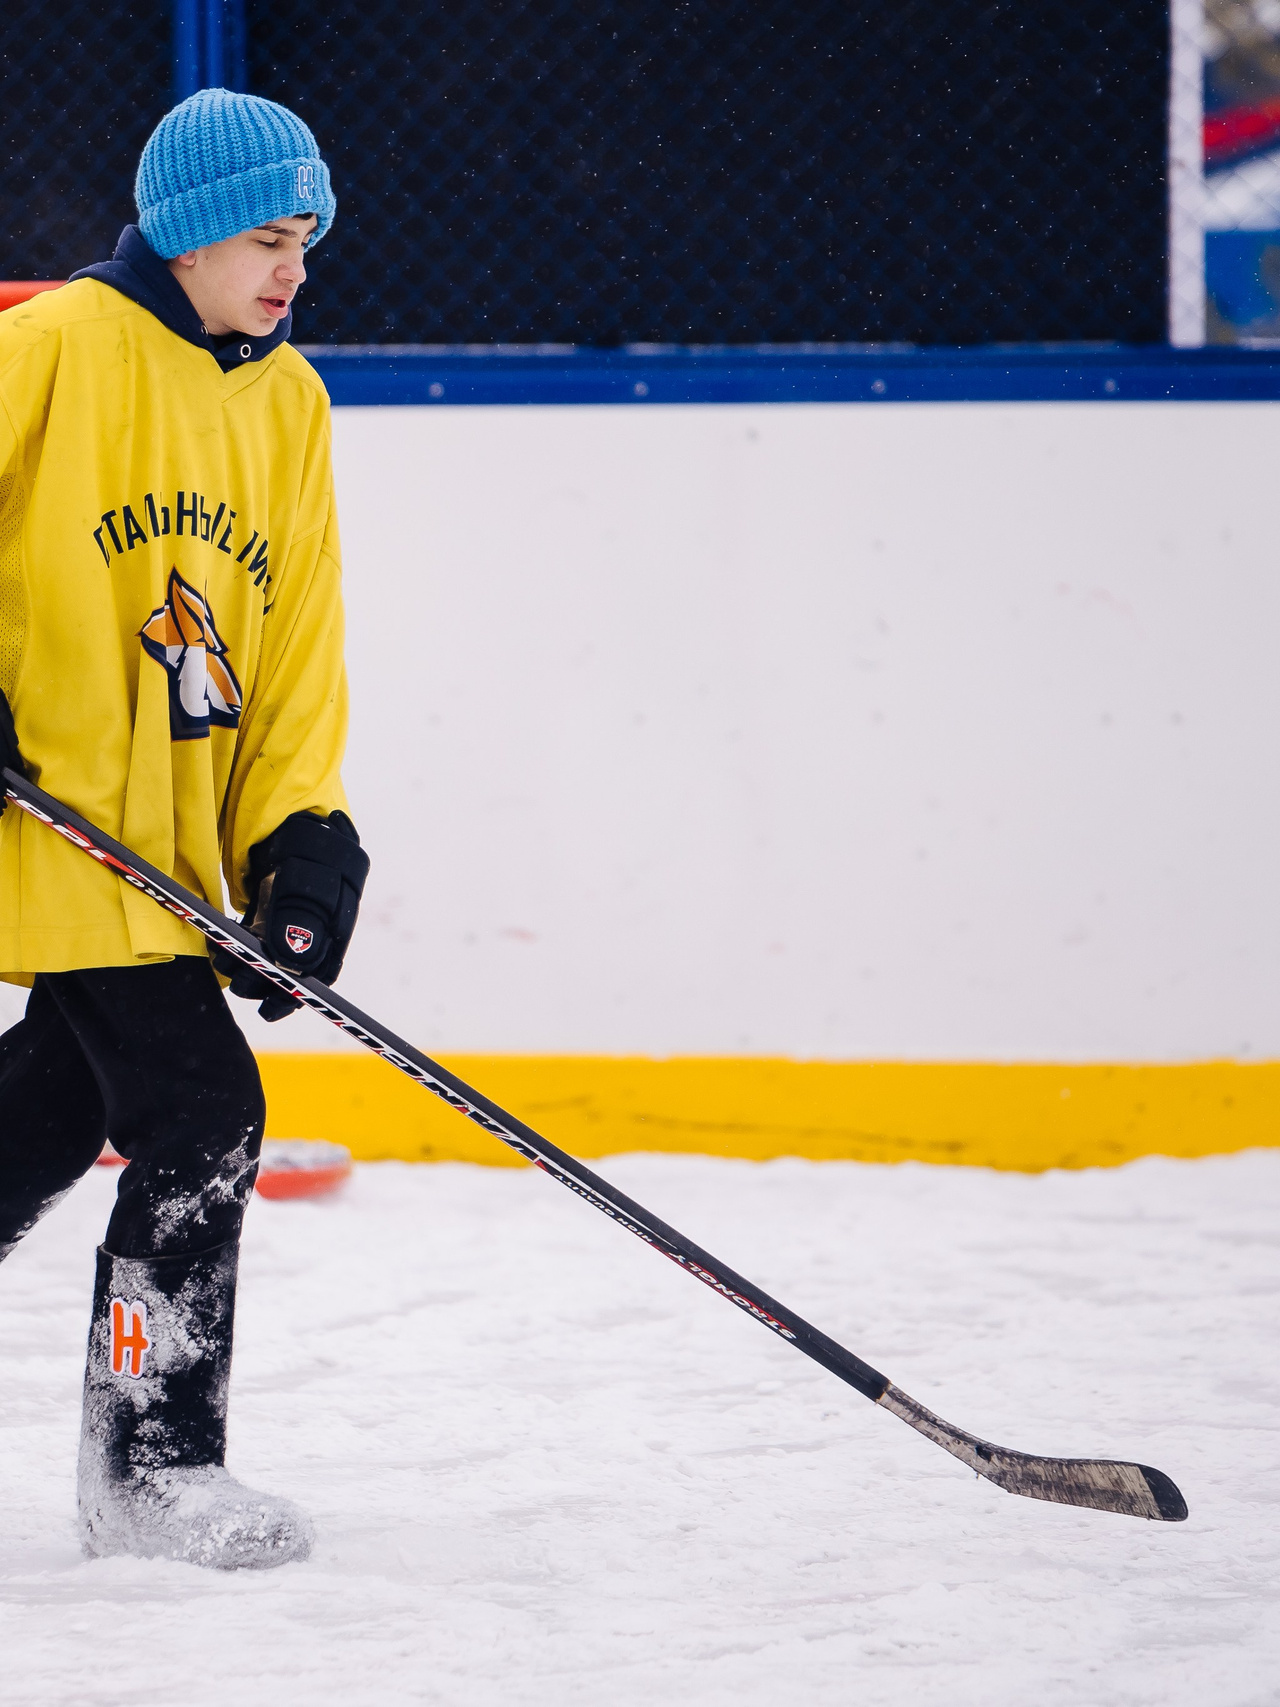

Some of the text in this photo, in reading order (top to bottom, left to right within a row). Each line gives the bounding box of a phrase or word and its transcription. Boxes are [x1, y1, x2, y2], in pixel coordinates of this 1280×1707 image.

[125, 874, 186, 917] PRO
[188, 915, 539, 1162] VANCOUVER
[553, 1173, 615, 1216] QUALITY
[668, 1251, 798, 1340] STRONGLY
